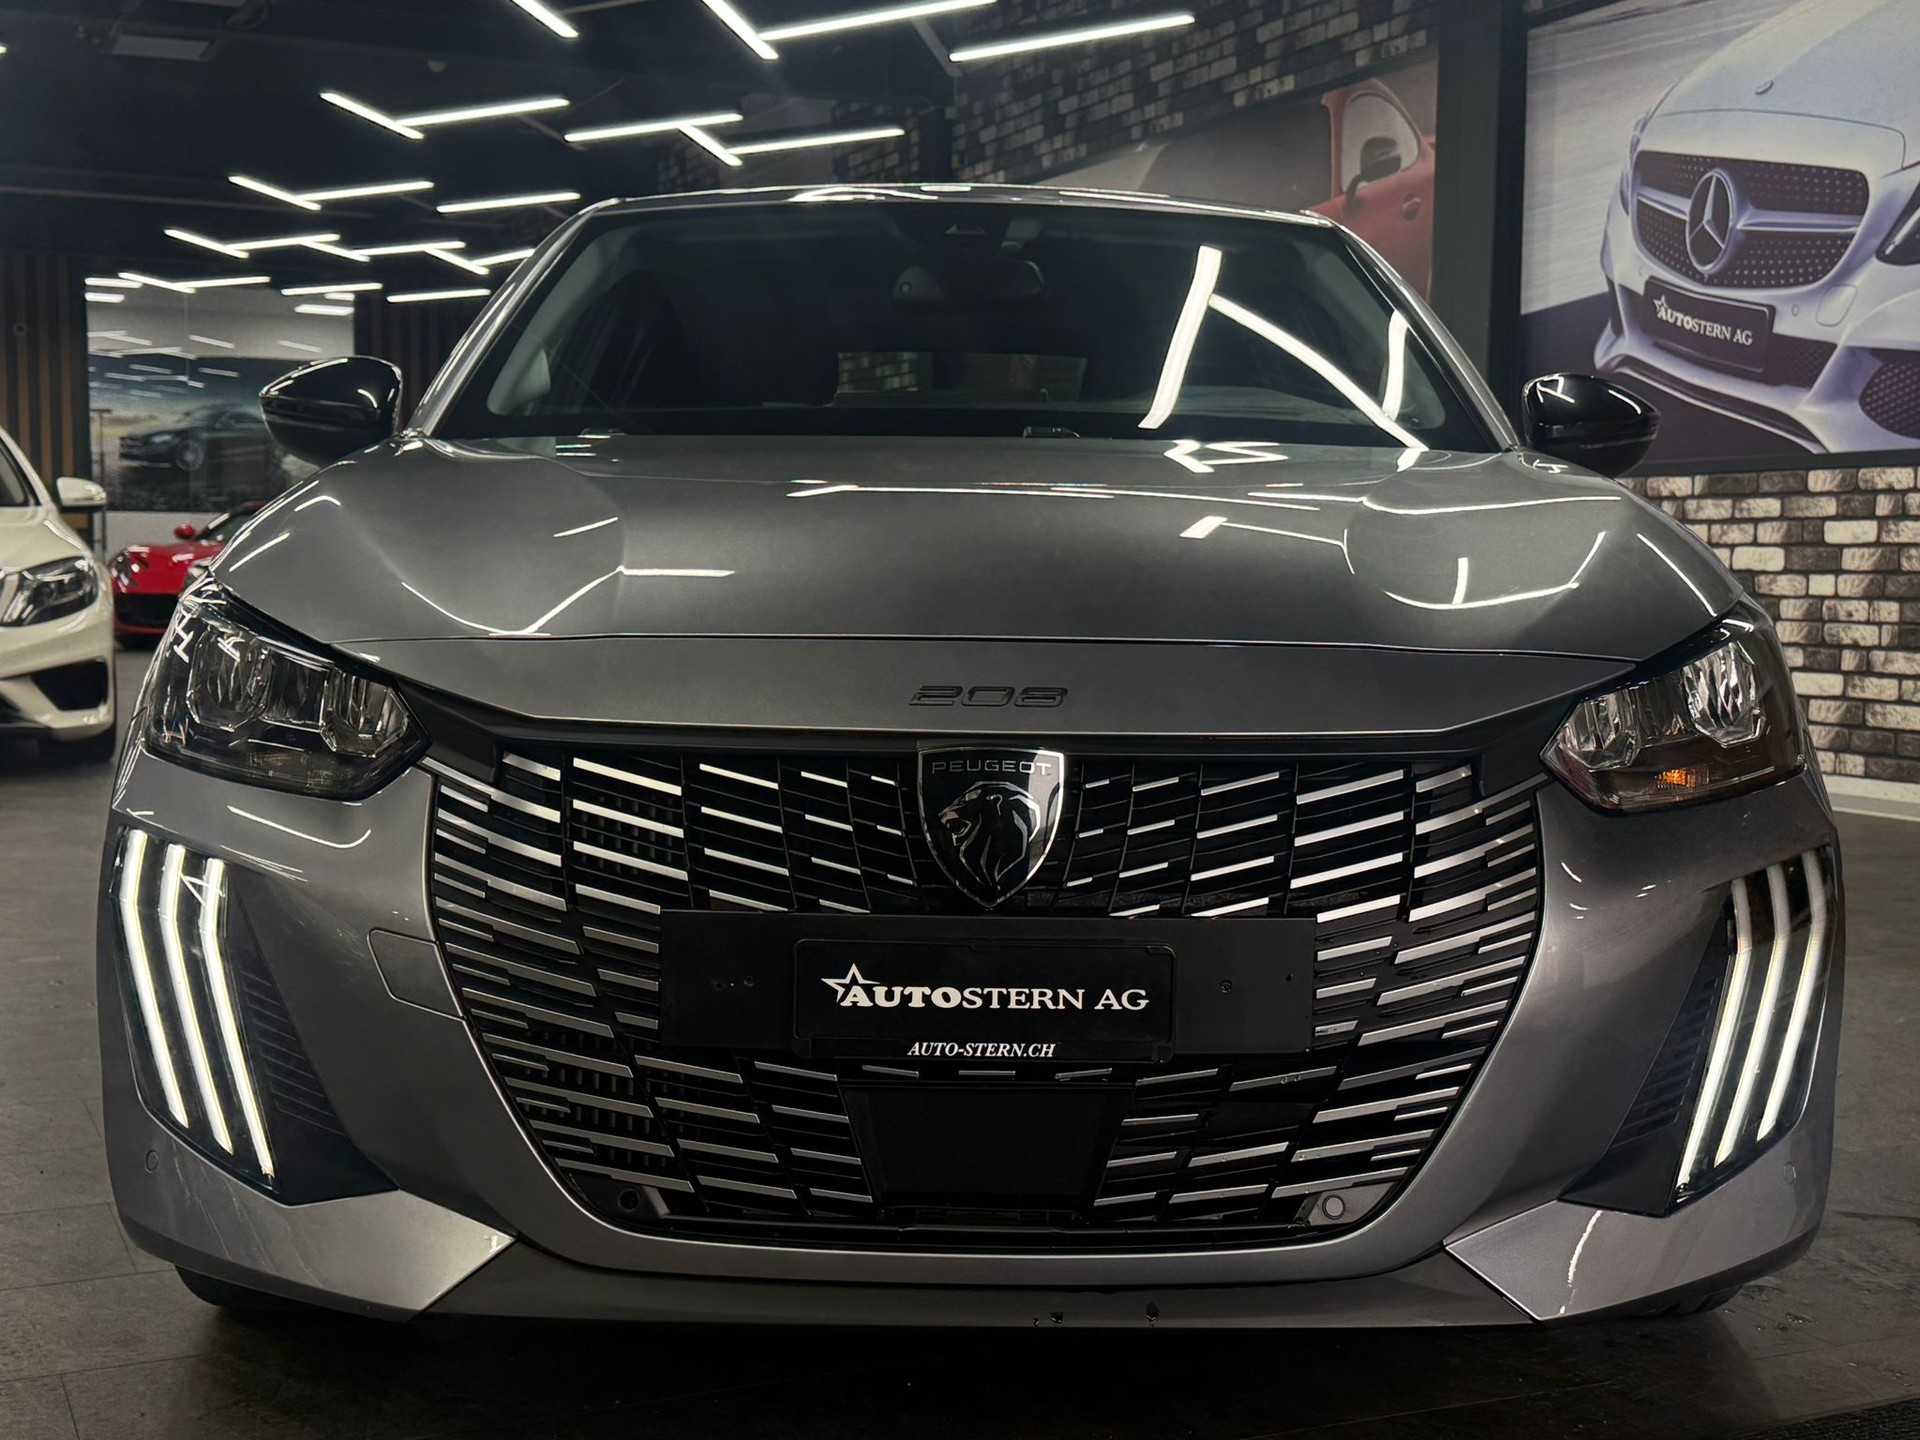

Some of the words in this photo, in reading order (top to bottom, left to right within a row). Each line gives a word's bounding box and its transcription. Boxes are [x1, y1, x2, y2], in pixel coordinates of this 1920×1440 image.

[1657, 306, 1731, 341] AUTOSTERN
[1733, 328, 1753, 346] AG
[909, 685, 1069, 708] 208
[931, 759, 1052, 775] PEUGEOT
[840, 986, 1083, 1010] AUTOSTERN
[1094, 988, 1149, 1011] AG
[907, 1041, 1056, 1058] AUTO-STERN.CH
